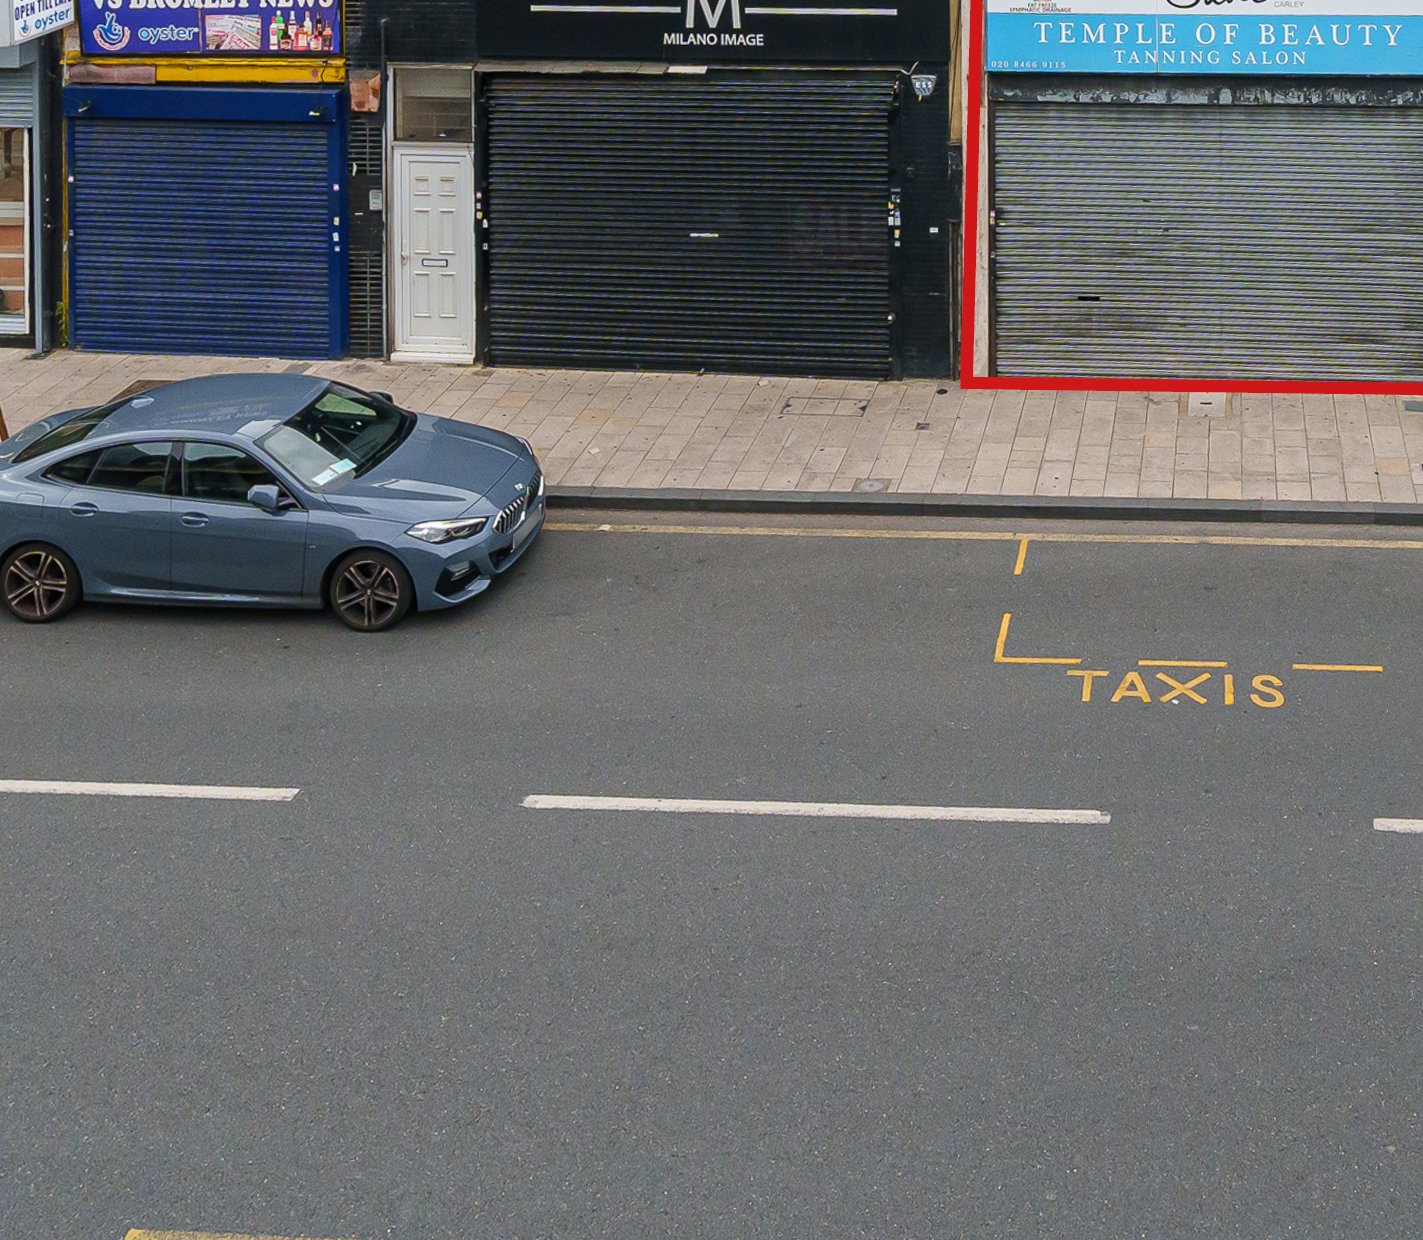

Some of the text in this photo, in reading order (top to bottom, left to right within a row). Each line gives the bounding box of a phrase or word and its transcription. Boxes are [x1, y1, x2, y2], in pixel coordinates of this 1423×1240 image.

[14, 1, 36, 20] OPEN
[34, 8, 71, 30] oyster
[138, 24, 199, 45] oyster
[663, 33, 764, 46] MILANO IMAGE
[1033, 22, 1403, 46] TEMPLE OF BEAUTY
[991, 60, 1066, 69] 020 8466 9115
[1114, 49, 1306, 65] TANNING SALON
[1066, 670, 1286, 708] TAXIS
